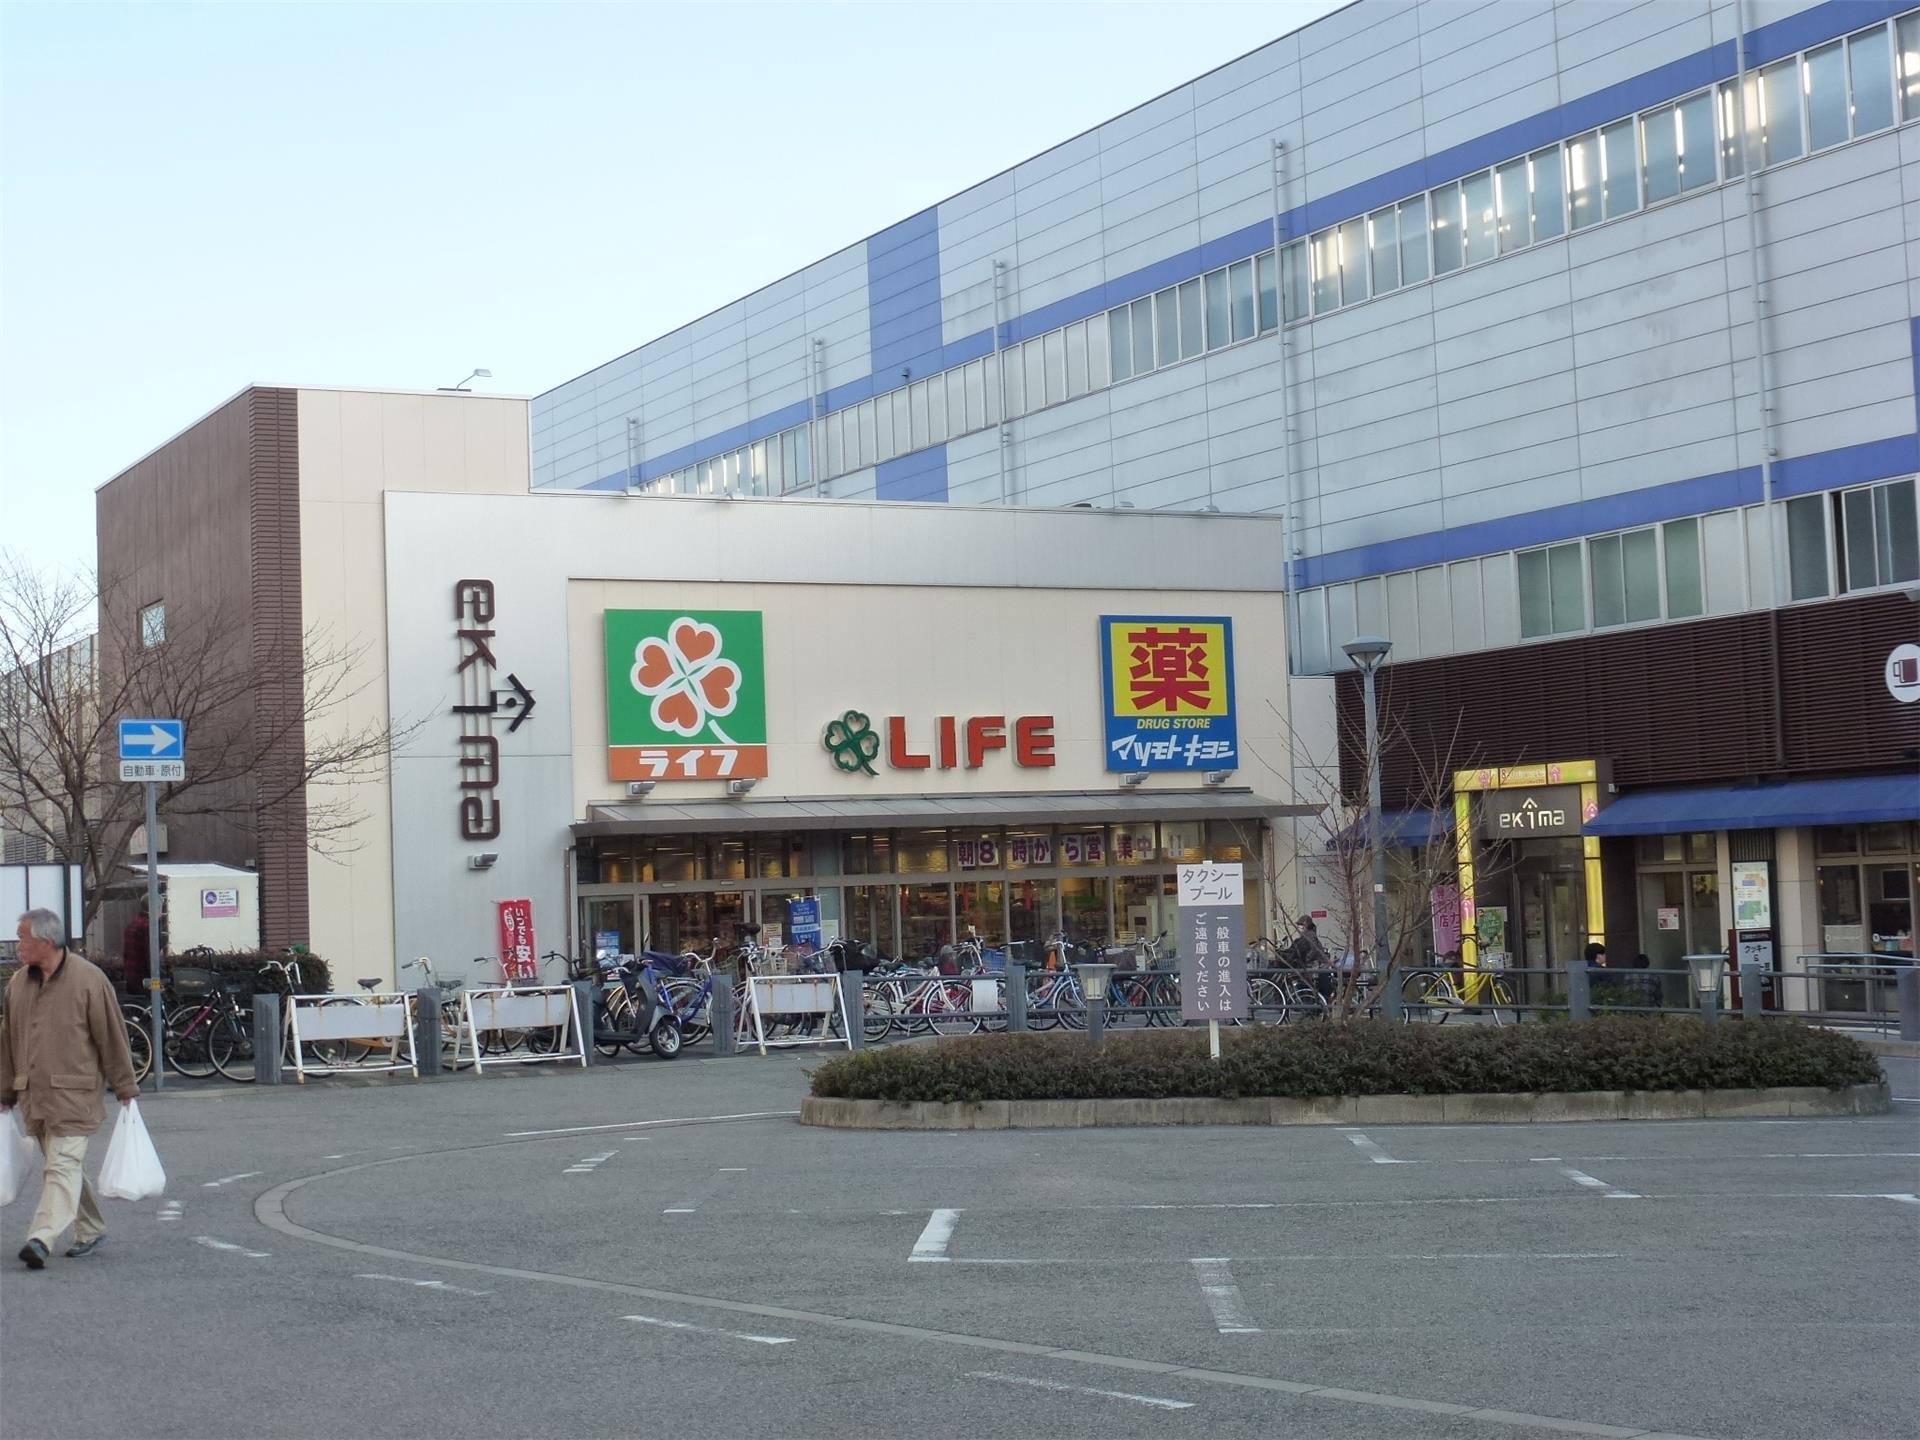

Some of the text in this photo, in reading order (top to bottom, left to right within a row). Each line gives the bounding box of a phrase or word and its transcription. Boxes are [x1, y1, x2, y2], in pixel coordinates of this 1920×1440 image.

[1128, 627, 1211, 712] 薬
[1136, 718, 1211, 729] DRUG STORE
[886, 715, 1056, 769] LIFE
[1111, 734, 1235, 767] マツモトキヨシ
[639, 750, 739, 777] ライフ
[1499, 803, 1565, 829] ekima
[1182, 868, 1239, 884] タクシー
[1190, 886, 1233, 901] プール
[1194, 912, 1210, 1012] ご遠慮ください
[1216, 913, 1232, 1012] 一般車の進入は
